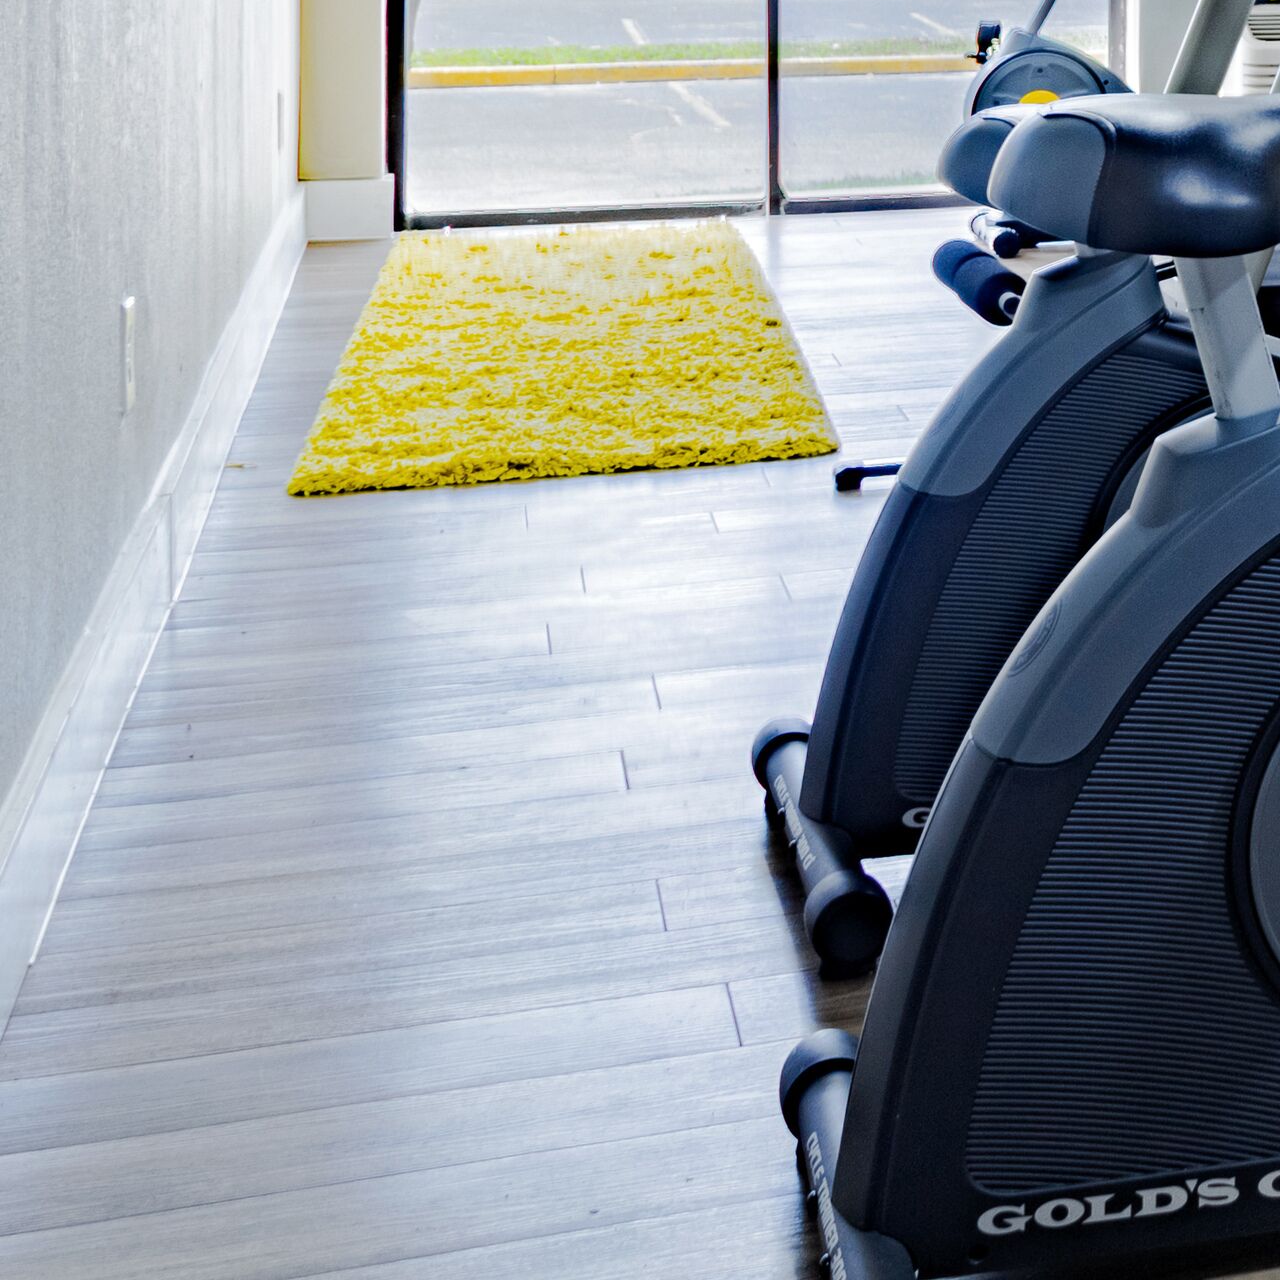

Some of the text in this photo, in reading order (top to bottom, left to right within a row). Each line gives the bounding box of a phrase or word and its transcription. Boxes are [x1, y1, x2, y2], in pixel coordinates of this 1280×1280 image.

[806, 1130, 825, 1187] CYCLE
[817, 1176, 839, 1254] TRAINER
[976, 1176, 1241, 1236] GOLD'S
